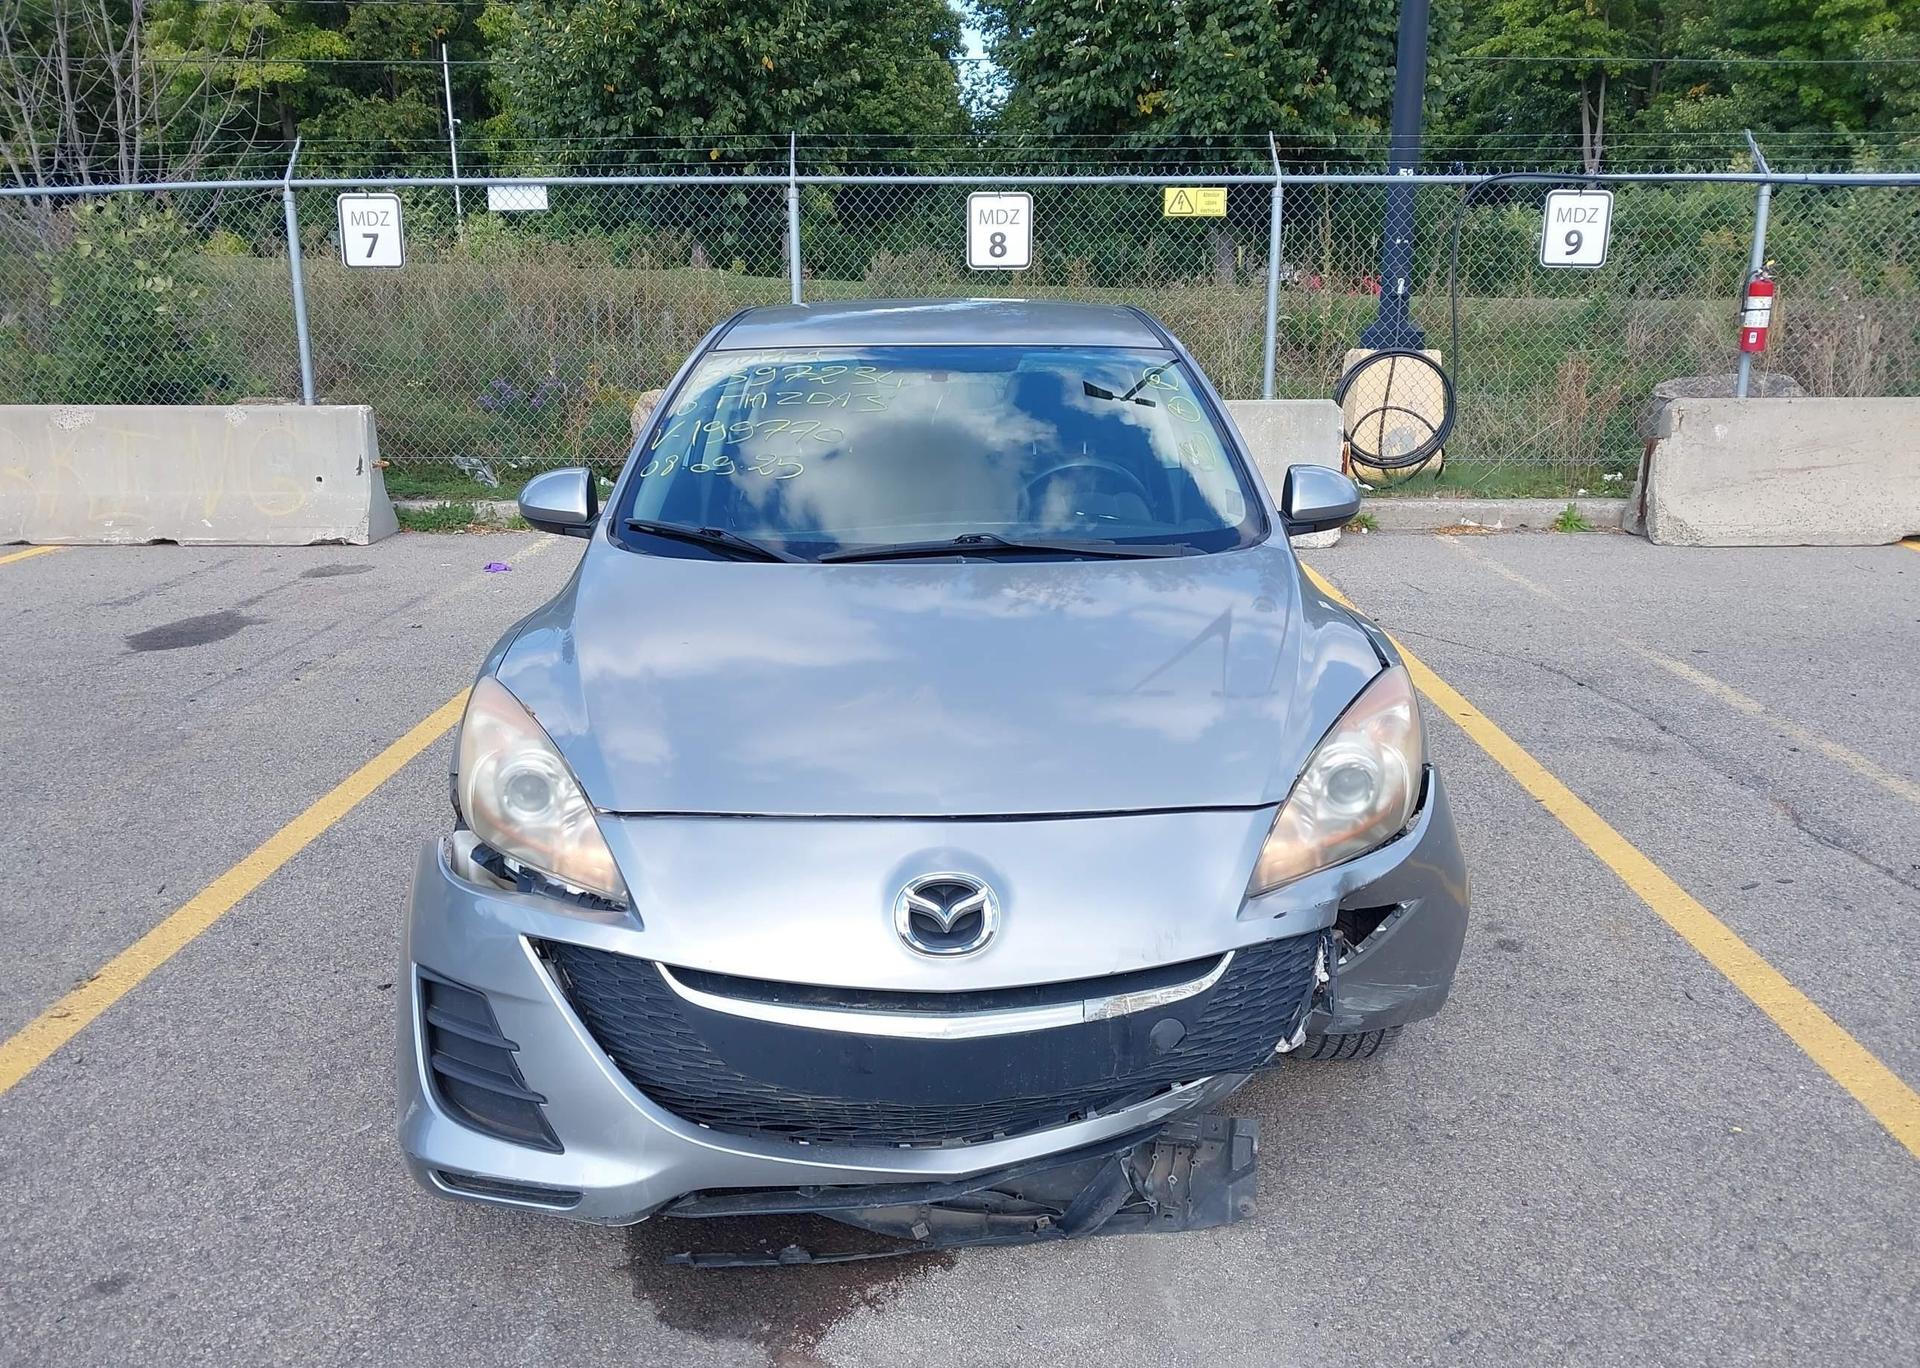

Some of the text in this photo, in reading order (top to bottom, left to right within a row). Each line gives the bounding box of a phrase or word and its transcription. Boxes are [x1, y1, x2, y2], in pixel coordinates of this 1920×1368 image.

[350, 210, 391, 227] MDZ
[979, 208, 1020, 225] MDZ
[1556, 207, 1600, 224] MDZ
[362, 233, 379, 258] 7
[989, 232, 1007, 258] 8
[1564, 229, 1583, 256] 9
